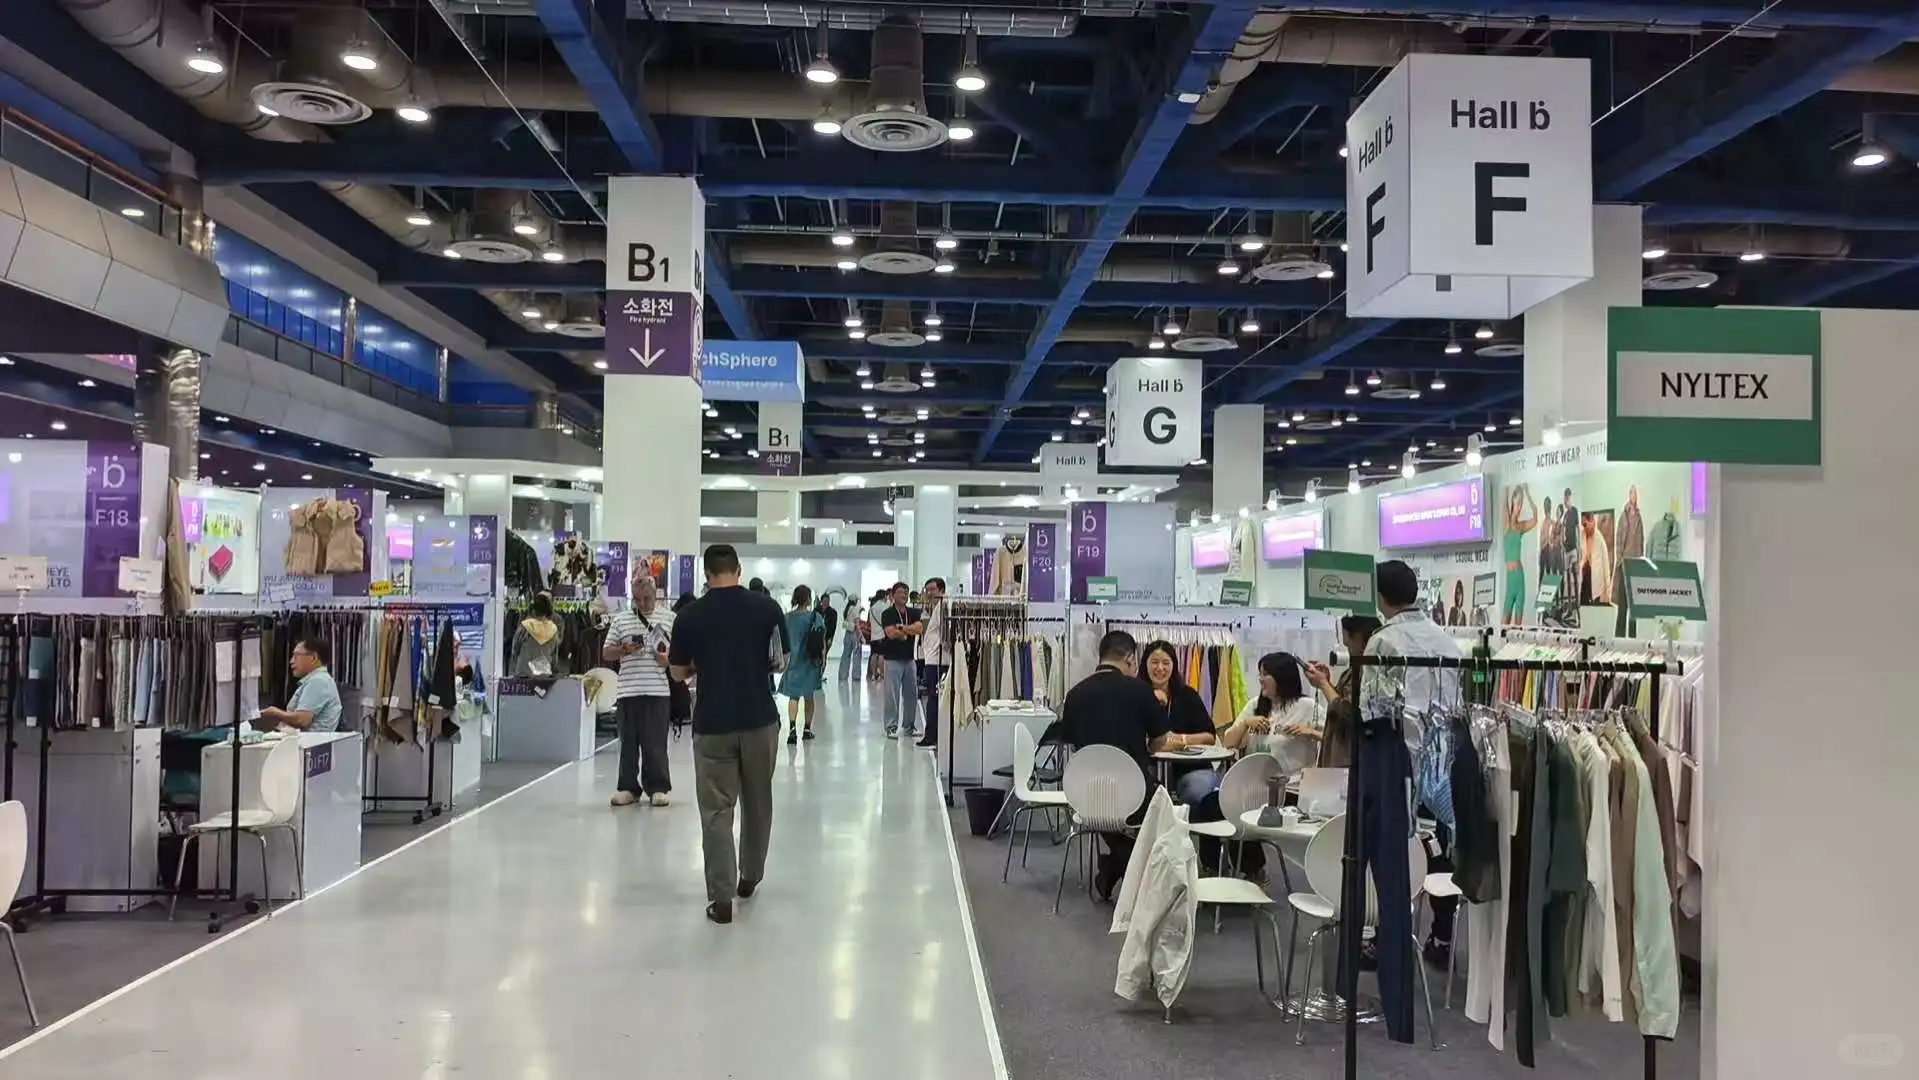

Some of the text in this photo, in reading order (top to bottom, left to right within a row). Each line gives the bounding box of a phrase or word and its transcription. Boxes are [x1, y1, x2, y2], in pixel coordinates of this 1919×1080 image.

[1451, 99, 1517, 129] Hall
[1358, 126, 1382, 173] Hall
[1474, 161, 1530, 246] F
[1366, 181, 1386, 275] F
[628, 243, 669, 282] B1
[623, 298, 673, 316] 소화전
[1138, 379, 1168, 393] Hall
[1660, 372, 1768, 399] NYLTEX
[1143, 406, 1177, 444] G
[769, 427, 789, 447] B1
[1056, 455, 1077, 465] Hall
[1536, 445, 1581, 468] ACTIVE WEAR
[95, 509, 129, 526] F18
[1032, 556, 1052, 567] F20
[1637, 587, 1692, 597] OUTDOOR JACKET
